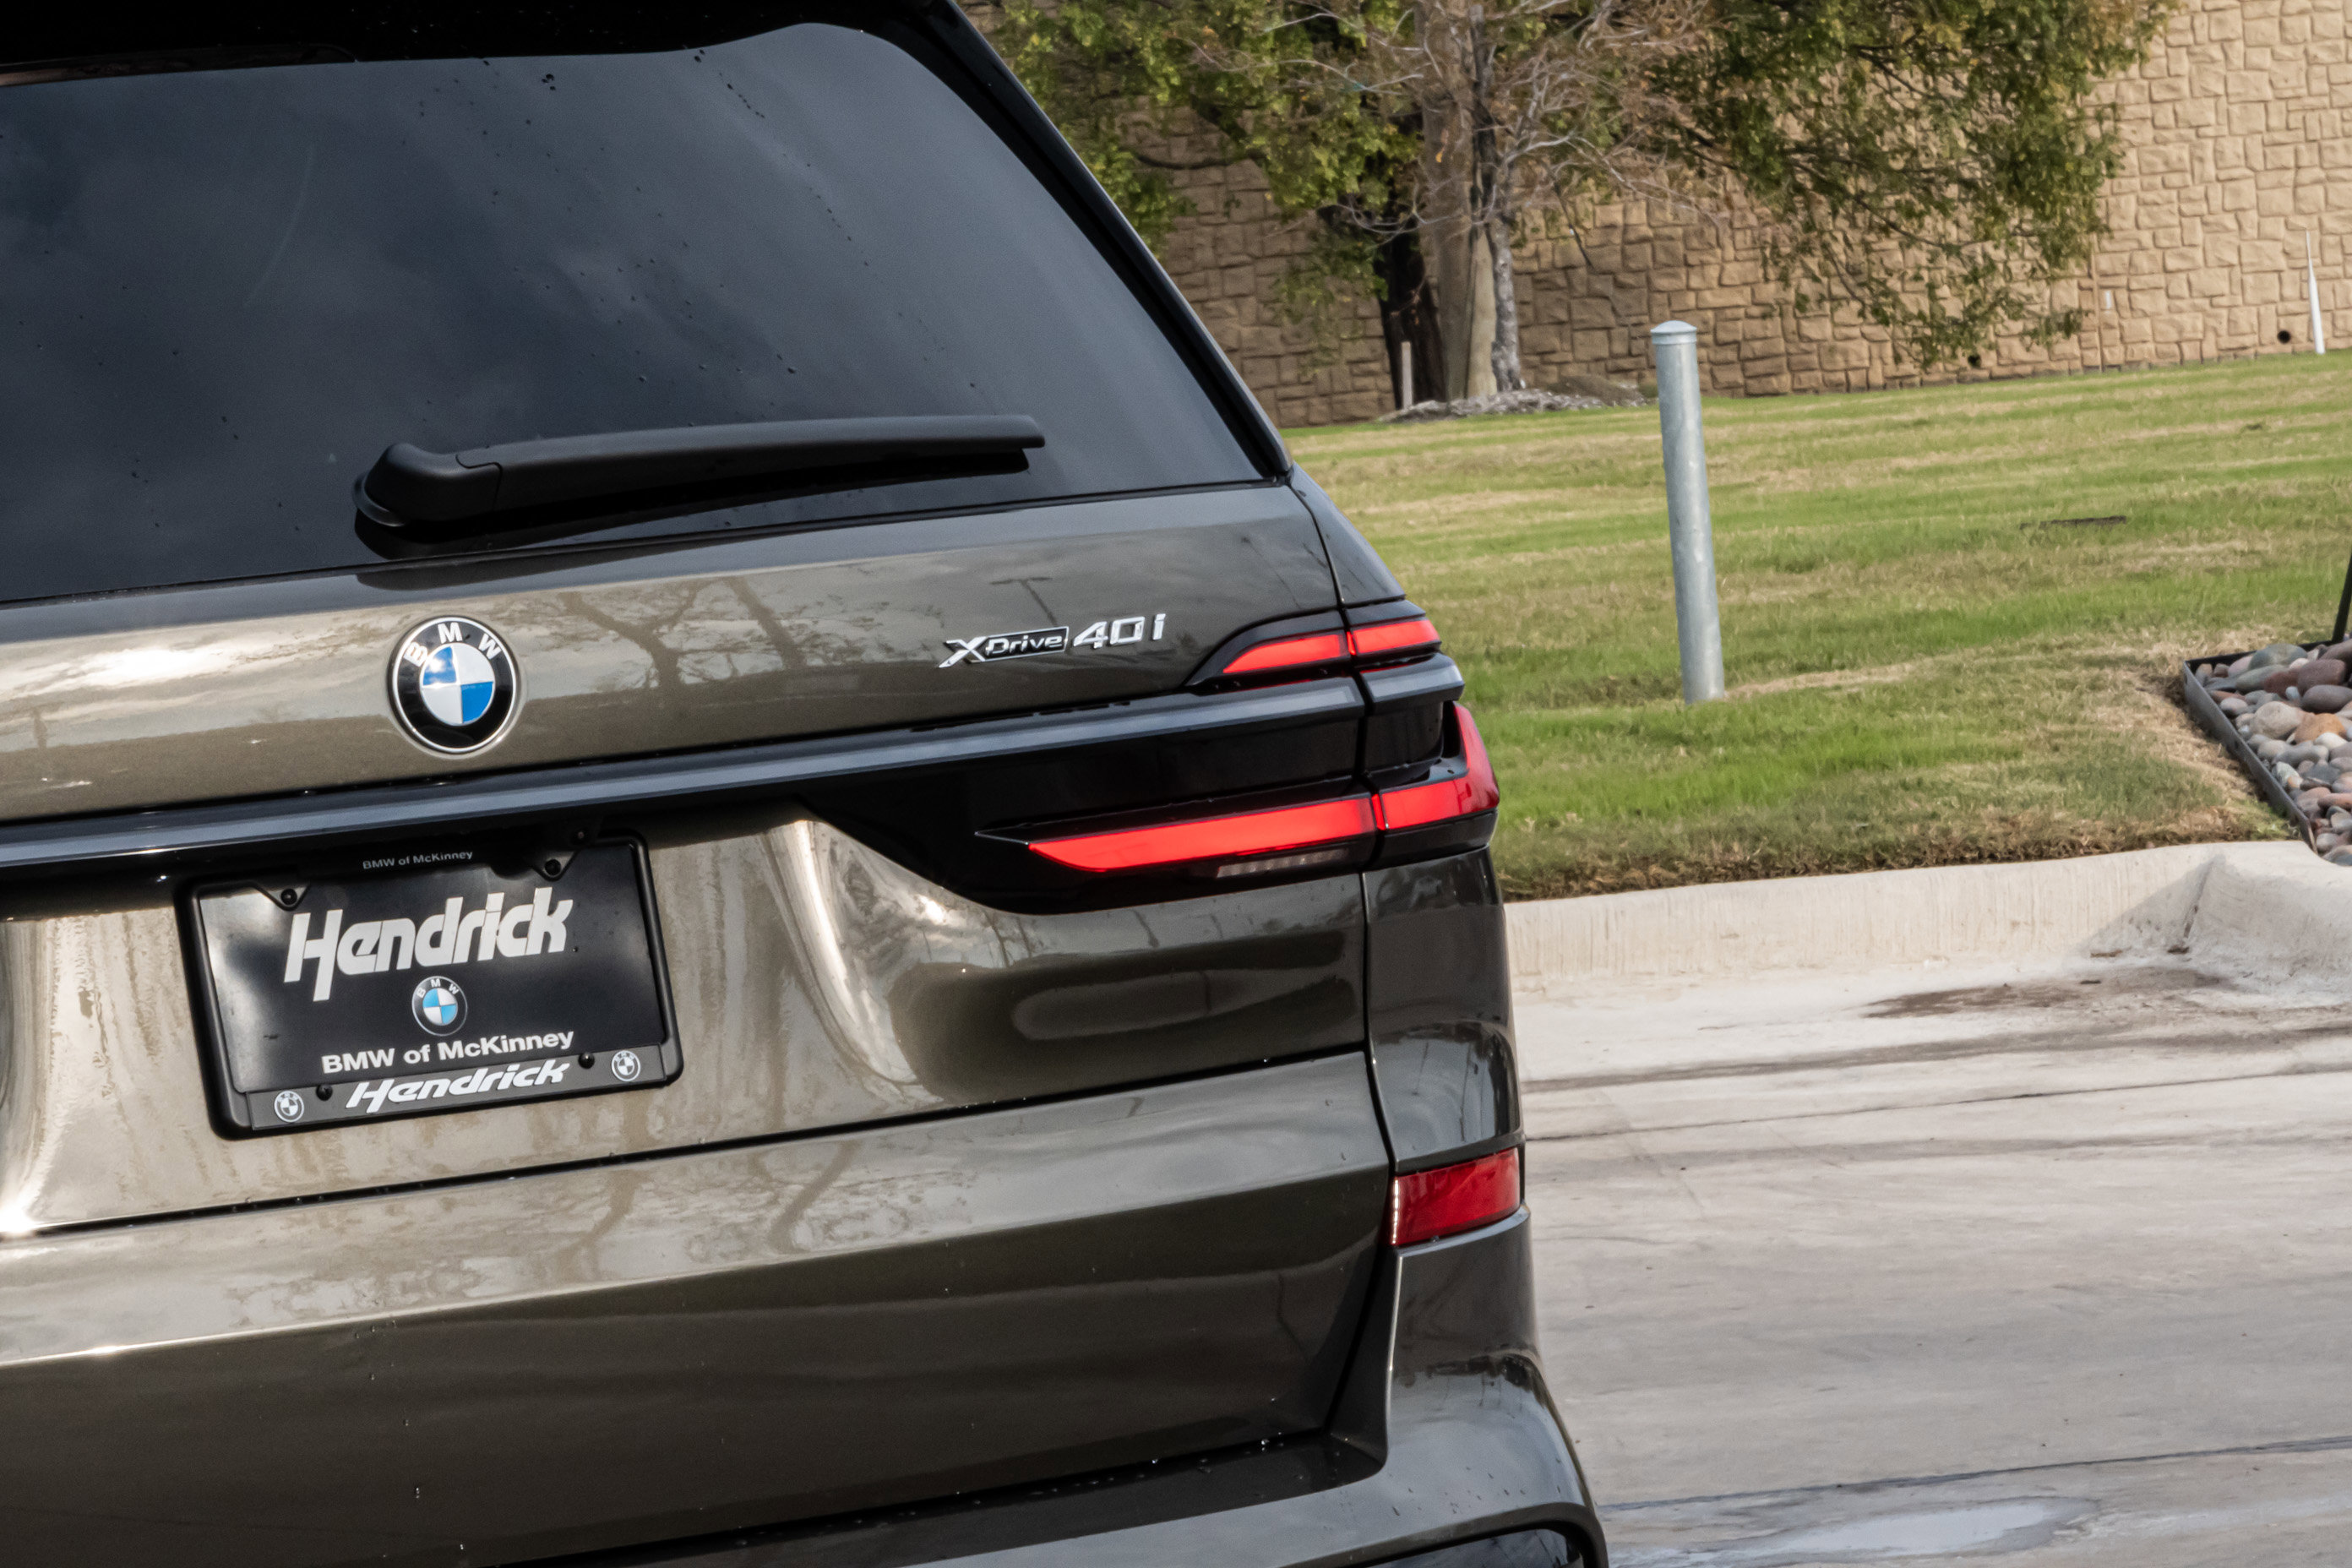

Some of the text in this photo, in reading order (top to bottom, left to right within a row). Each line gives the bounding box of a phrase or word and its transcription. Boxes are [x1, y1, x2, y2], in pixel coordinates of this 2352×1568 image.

[403, 622, 502, 667] BMW
[362, 851, 473, 869] BMW of McKinney
[284, 886, 574, 1002] Hendrick
[416, 978, 460, 999] BMW
[321, 1031, 574, 1074] BMW of McKinney
[346, 1059, 570, 1113] Hendrick
